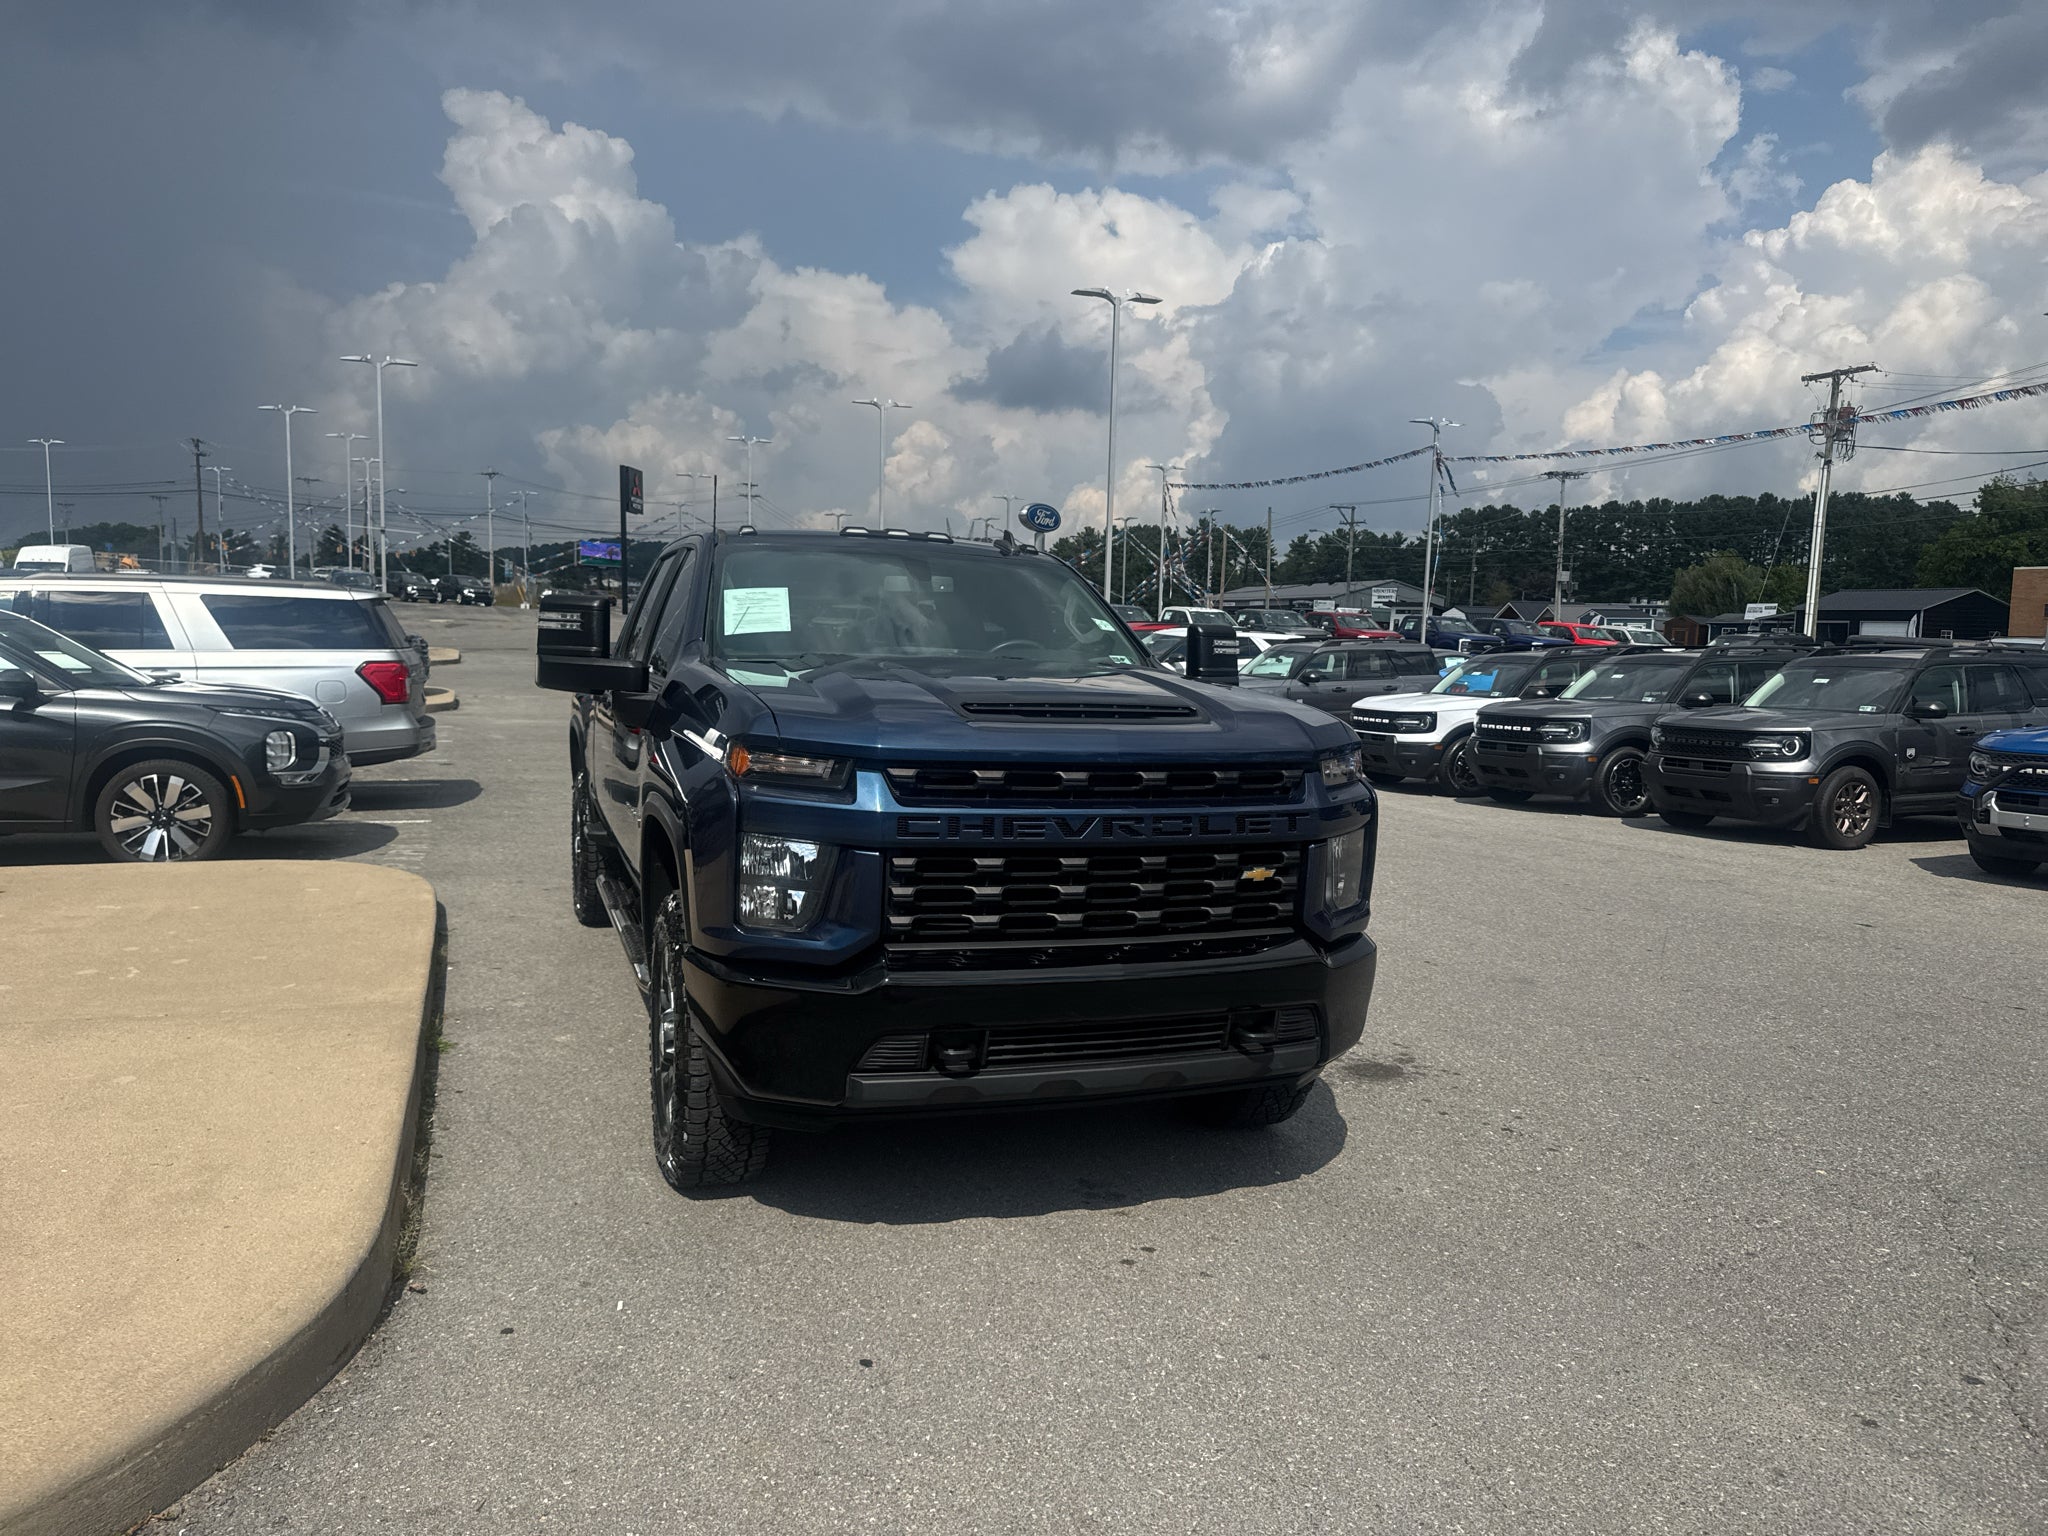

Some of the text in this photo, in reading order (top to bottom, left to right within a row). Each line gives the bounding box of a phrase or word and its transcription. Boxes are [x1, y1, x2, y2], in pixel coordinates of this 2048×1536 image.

[1034, 508, 1056, 527] Ford
[1353, 715, 1390, 724] BRONCO
[1481, 723, 1532, 732] BRONCO
[896, 812, 1310, 840] CHEVROLET
